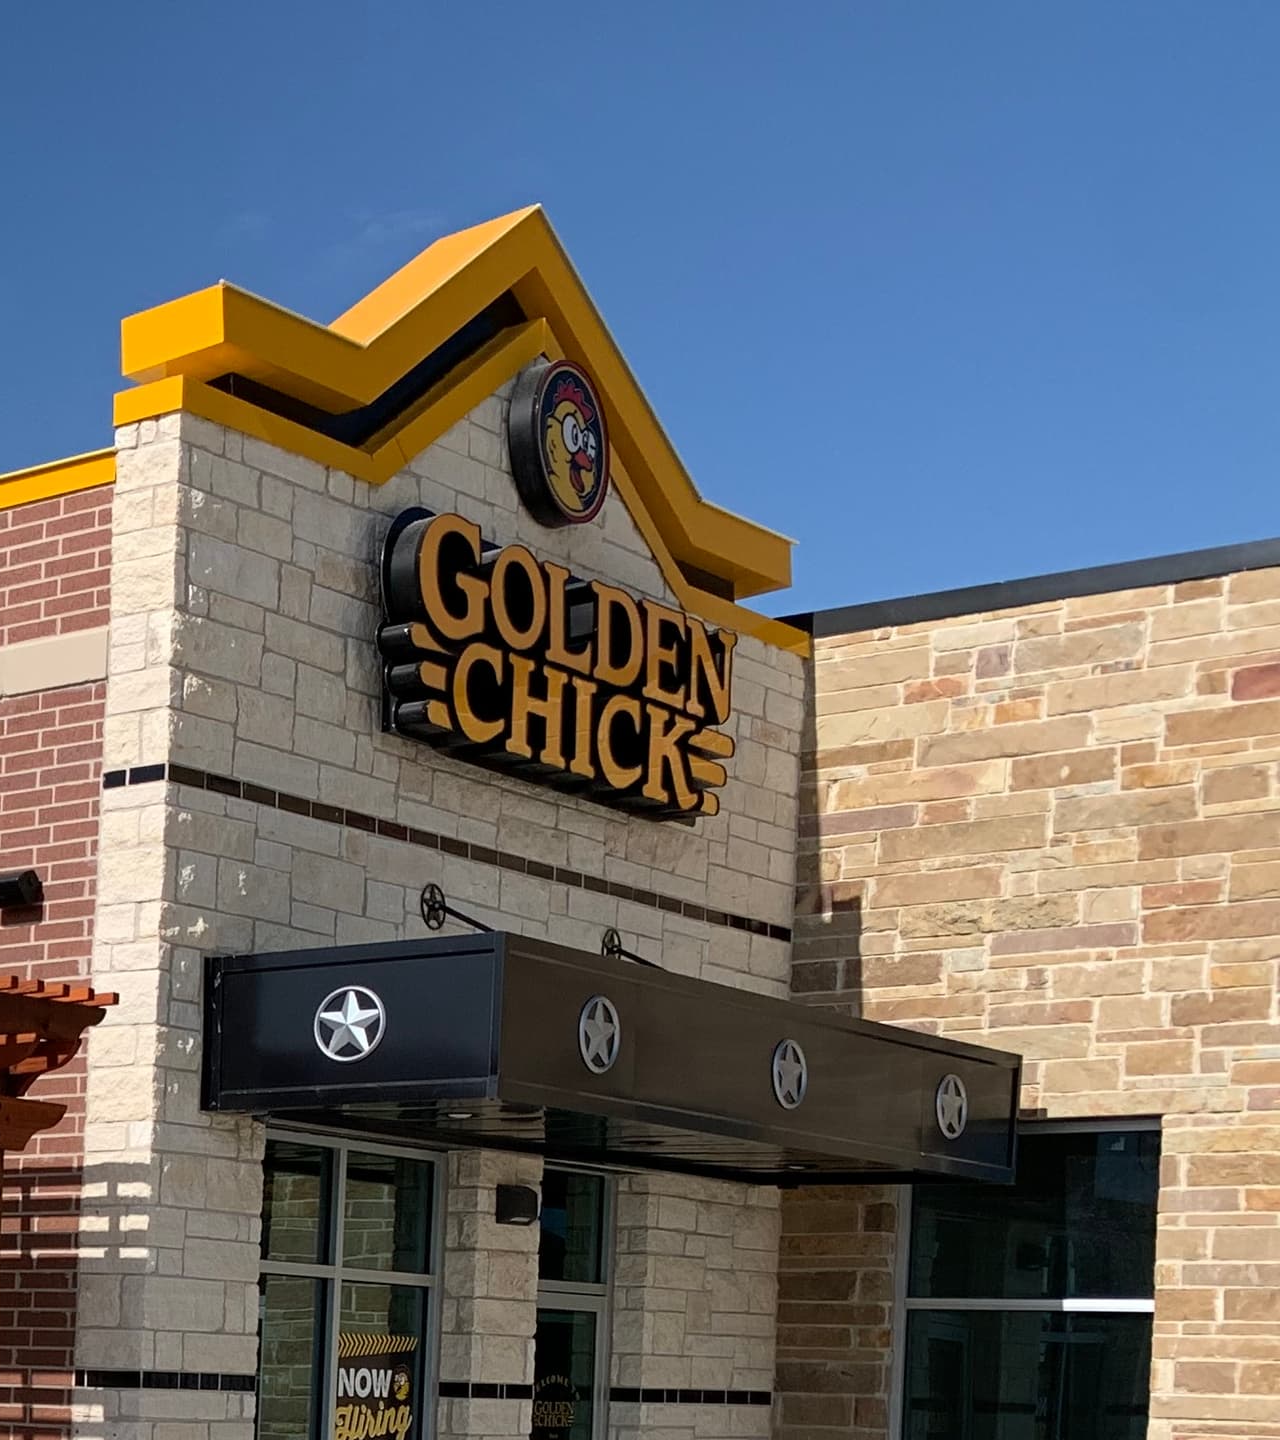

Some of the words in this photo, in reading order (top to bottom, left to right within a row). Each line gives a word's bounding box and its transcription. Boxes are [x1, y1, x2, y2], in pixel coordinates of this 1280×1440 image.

[419, 512, 738, 725] GOLDEN
[453, 642, 697, 811] CHICK
[337, 1367, 393, 1399] NOW
